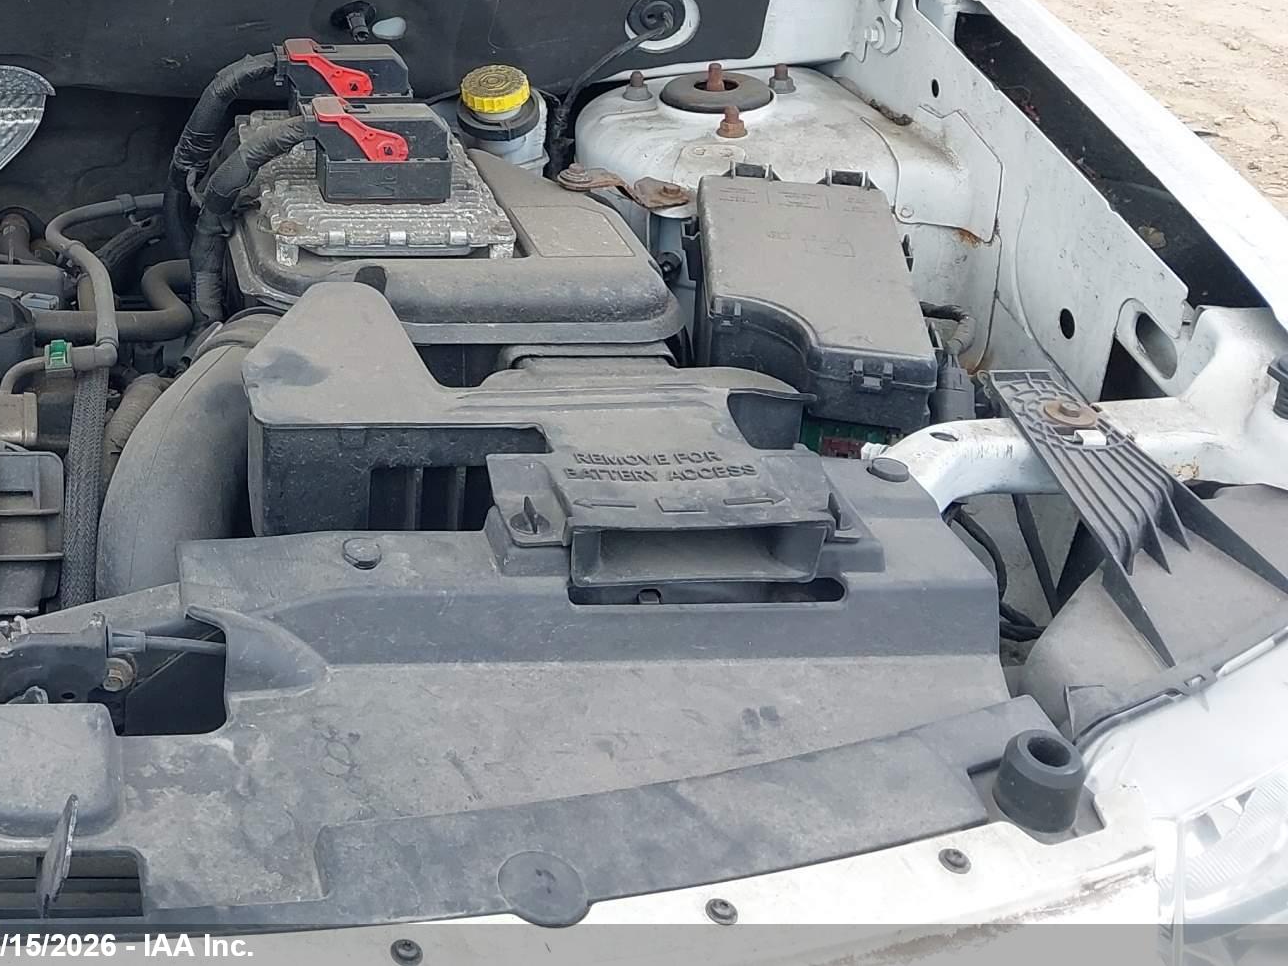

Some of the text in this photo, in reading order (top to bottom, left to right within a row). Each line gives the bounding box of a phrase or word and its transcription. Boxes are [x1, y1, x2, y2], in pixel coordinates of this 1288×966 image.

[573, 450, 722, 466] REMOVE FOR
[565, 464, 758, 482] BATTERY ACCESS
